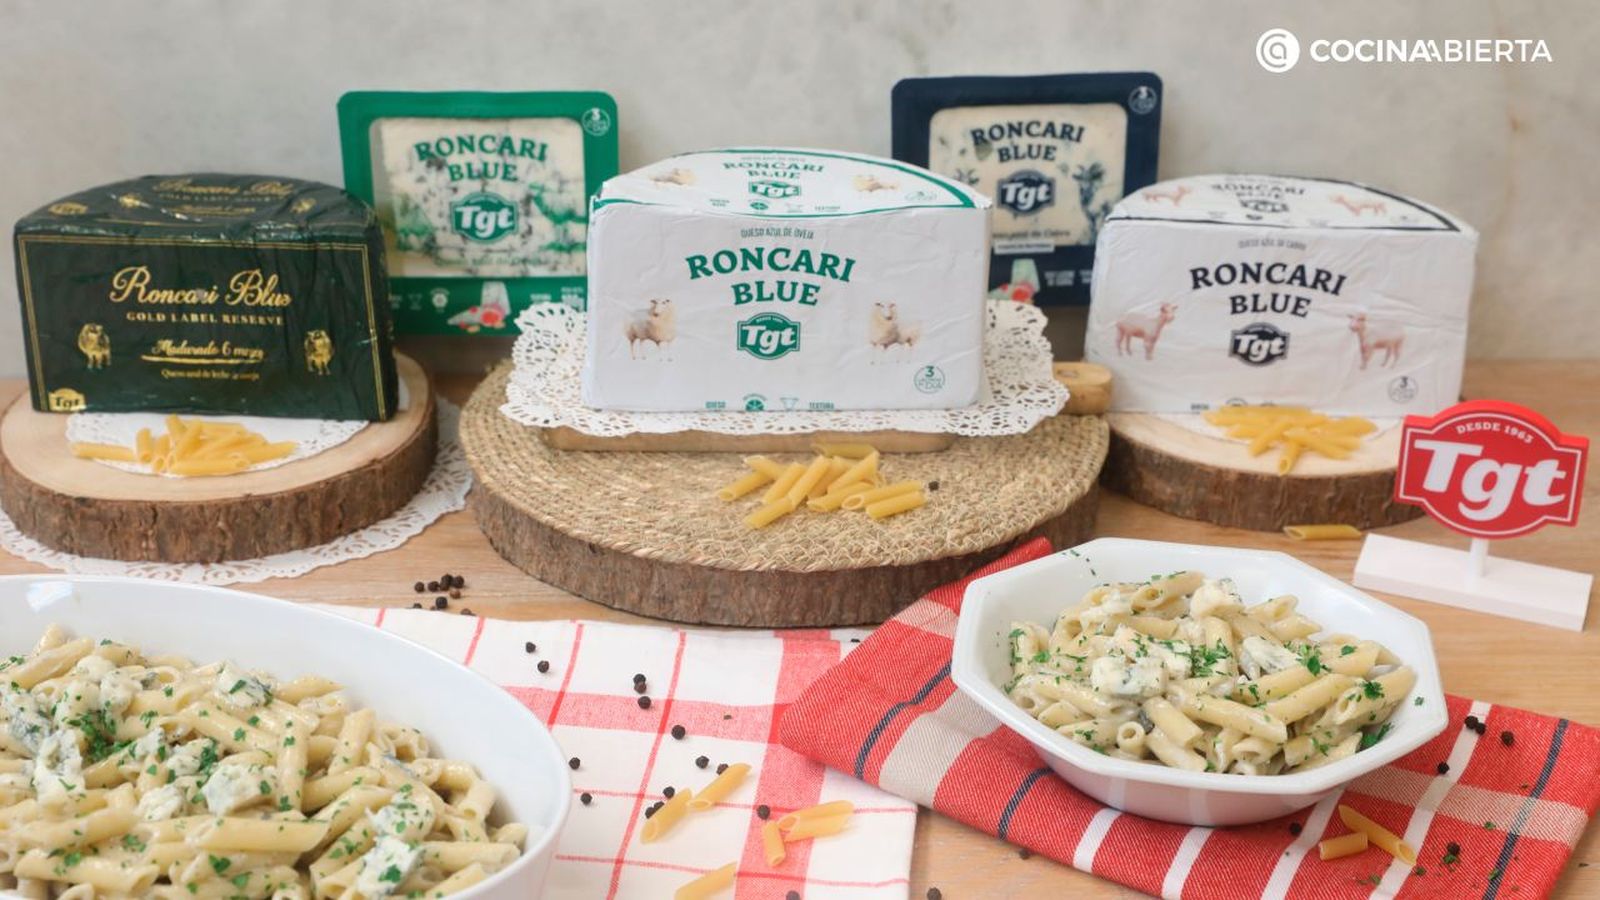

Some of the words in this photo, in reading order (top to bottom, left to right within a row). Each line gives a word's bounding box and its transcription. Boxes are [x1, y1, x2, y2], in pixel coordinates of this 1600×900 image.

[970, 120, 1085, 146] RONCARI
[413, 134, 549, 162] RONCARI
[997, 144, 1058, 163] BLUE
[447, 162, 519, 183] BLUE
[723, 161, 825, 173] RONCARI
[1002, 182, 1051, 211] Tgt
[455, 206, 513, 239] Tgt
[685, 246, 857, 282] RONCARI
[1189, 262, 1348, 296] RONCARI
[731, 280, 821, 307] BLUE
[1228, 292, 1313, 318] BLUE
[126, 311, 166, 322] GOLD
[171, 312, 218, 324] LABEL
[222, 314, 283, 326] RESERVE
[222, 341, 232, 356] 6
[742, 325, 796, 355] Tgt
[1235, 334, 1285, 362] Tgt
[925, 365, 935, 378] 3
[1400, 376, 1409, 389] 3
[1455, 421, 1501, 435] DESDE
[1414, 439, 1567, 521] Tgt
